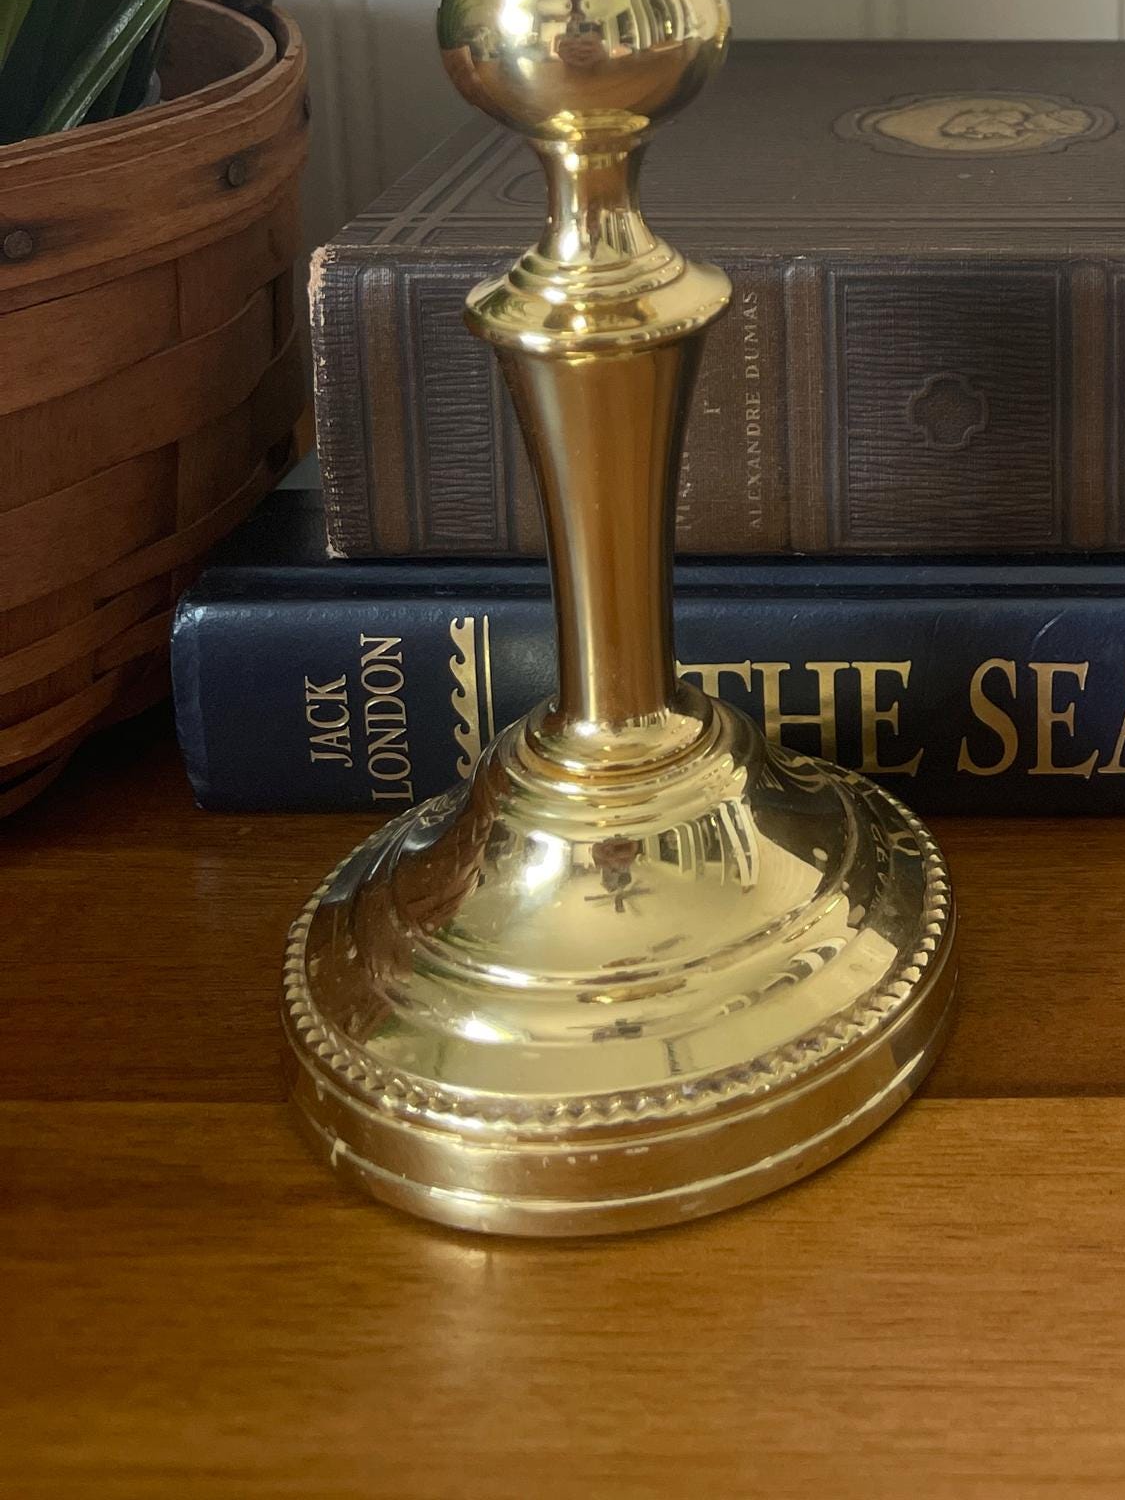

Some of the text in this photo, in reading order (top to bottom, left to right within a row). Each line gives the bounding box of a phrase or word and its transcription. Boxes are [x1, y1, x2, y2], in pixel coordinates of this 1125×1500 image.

[742, 291, 763, 531] ALEXANDRE DUMAS
[304, 673, 354, 769] JACK
[359, 632, 414, 804] LONDON
[676, 659, 924, 777] THE
